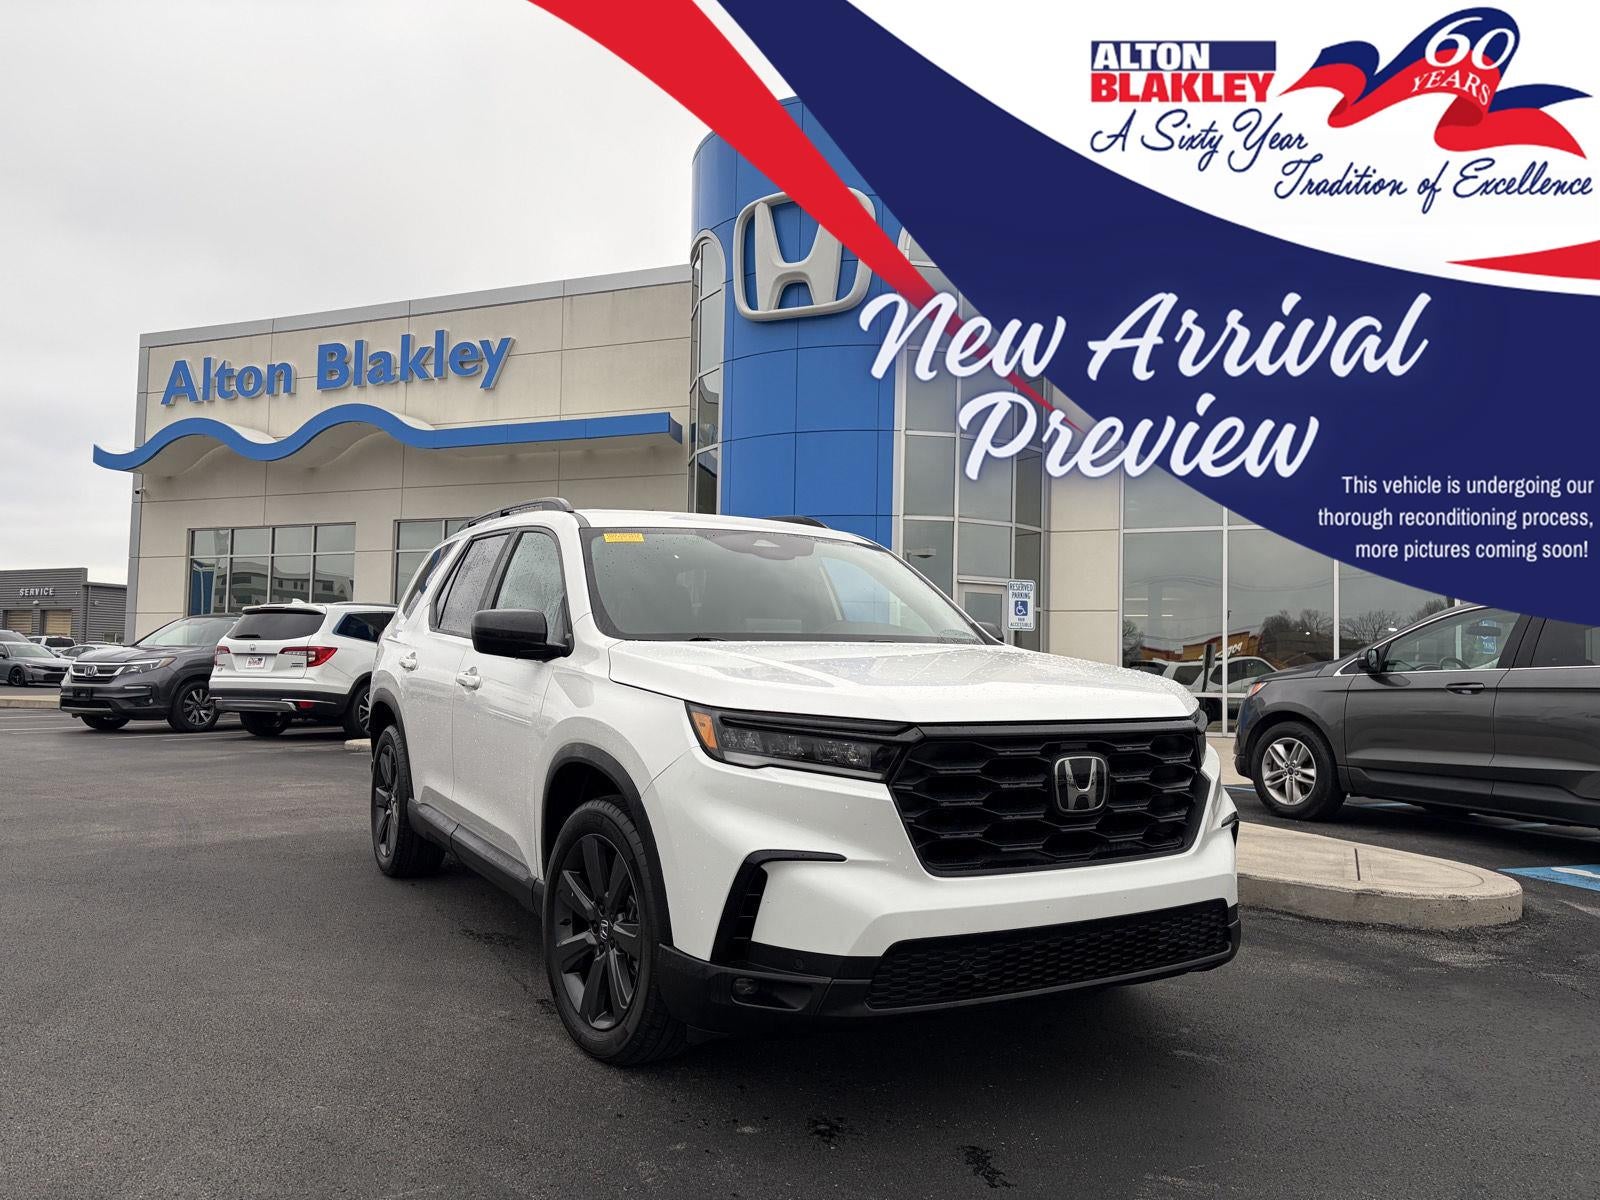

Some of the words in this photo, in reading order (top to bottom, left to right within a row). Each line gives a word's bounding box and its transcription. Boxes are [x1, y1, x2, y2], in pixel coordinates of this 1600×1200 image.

[161, 356, 297, 408] Alton
[316, 329, 516, 392] Blakley
[19, 587, 56, 597] SERVICE
[1010, 583, 1033, 591] RESERVED
